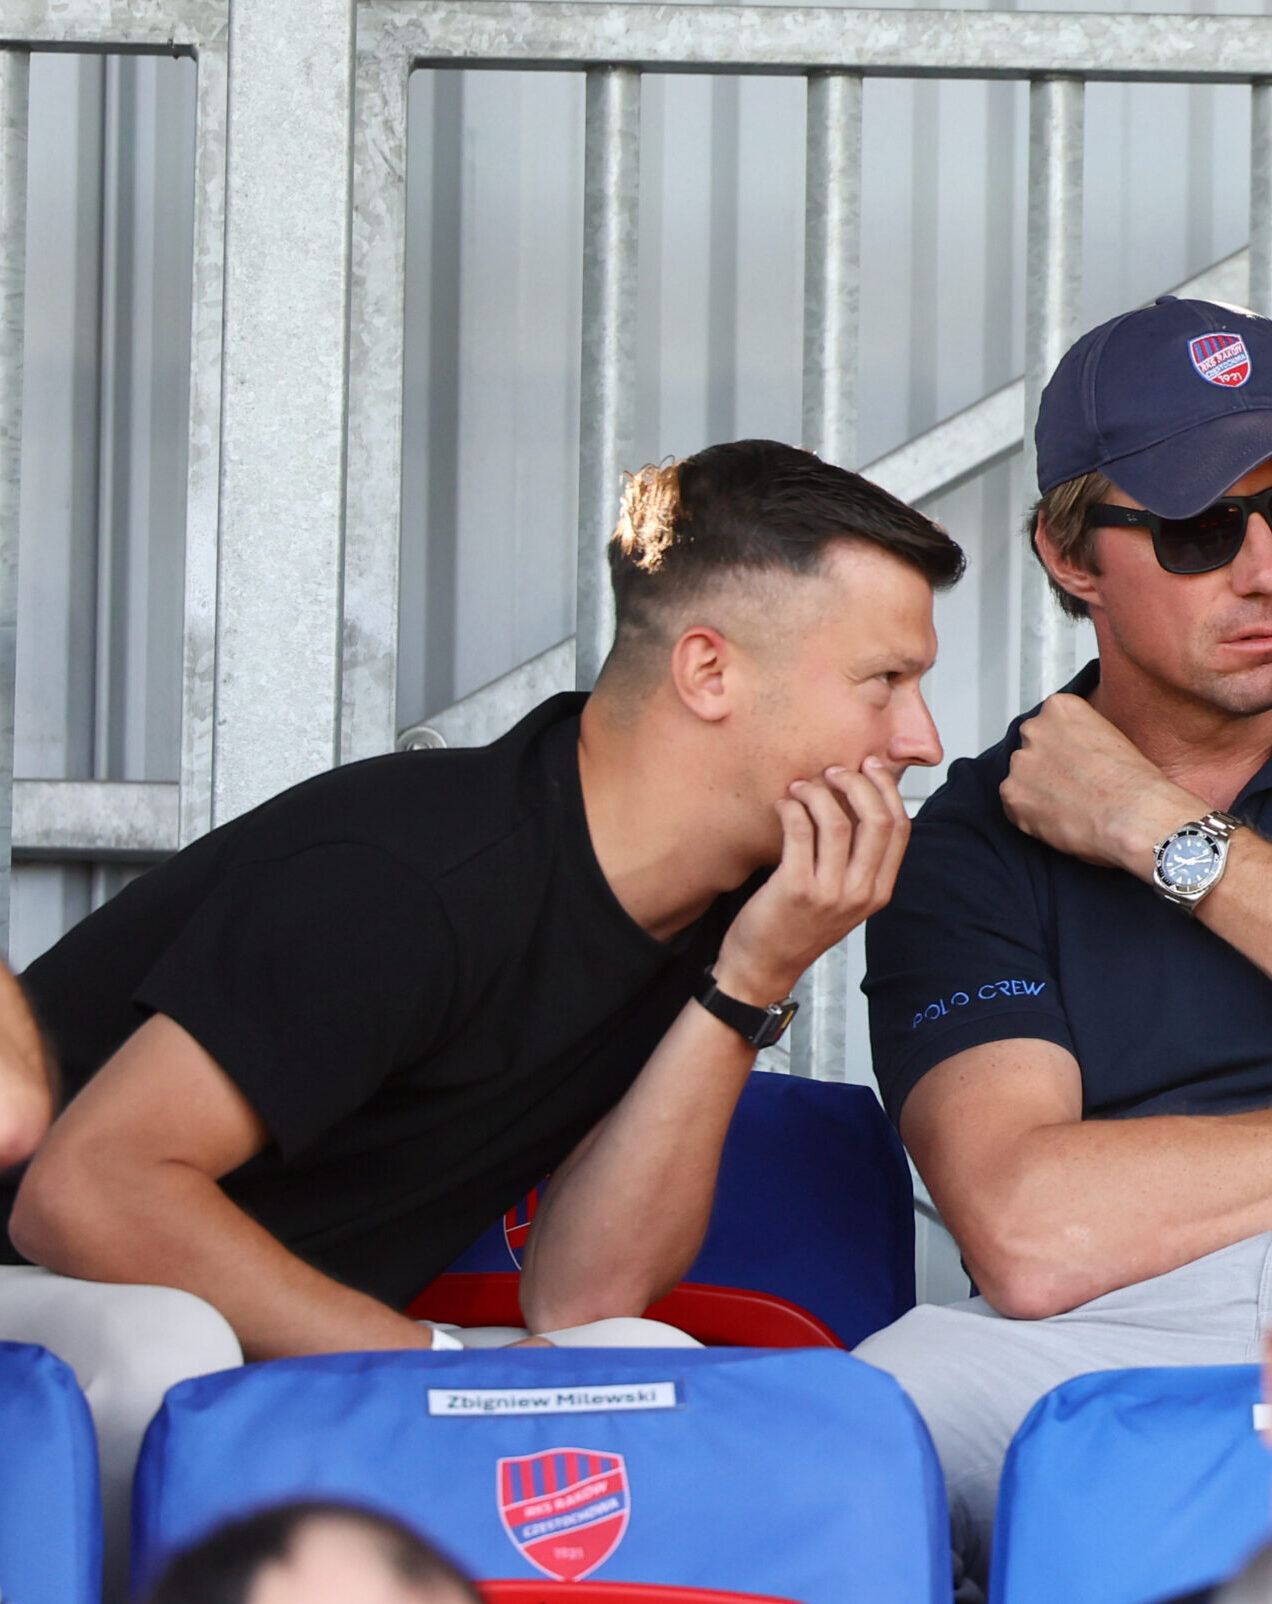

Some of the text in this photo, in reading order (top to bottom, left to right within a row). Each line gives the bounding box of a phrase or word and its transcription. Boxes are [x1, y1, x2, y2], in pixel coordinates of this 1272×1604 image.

[912, 979, 1046, 1029] POLO CREW
[447, 1389, 657, 1411] Zbigniew Milewski
